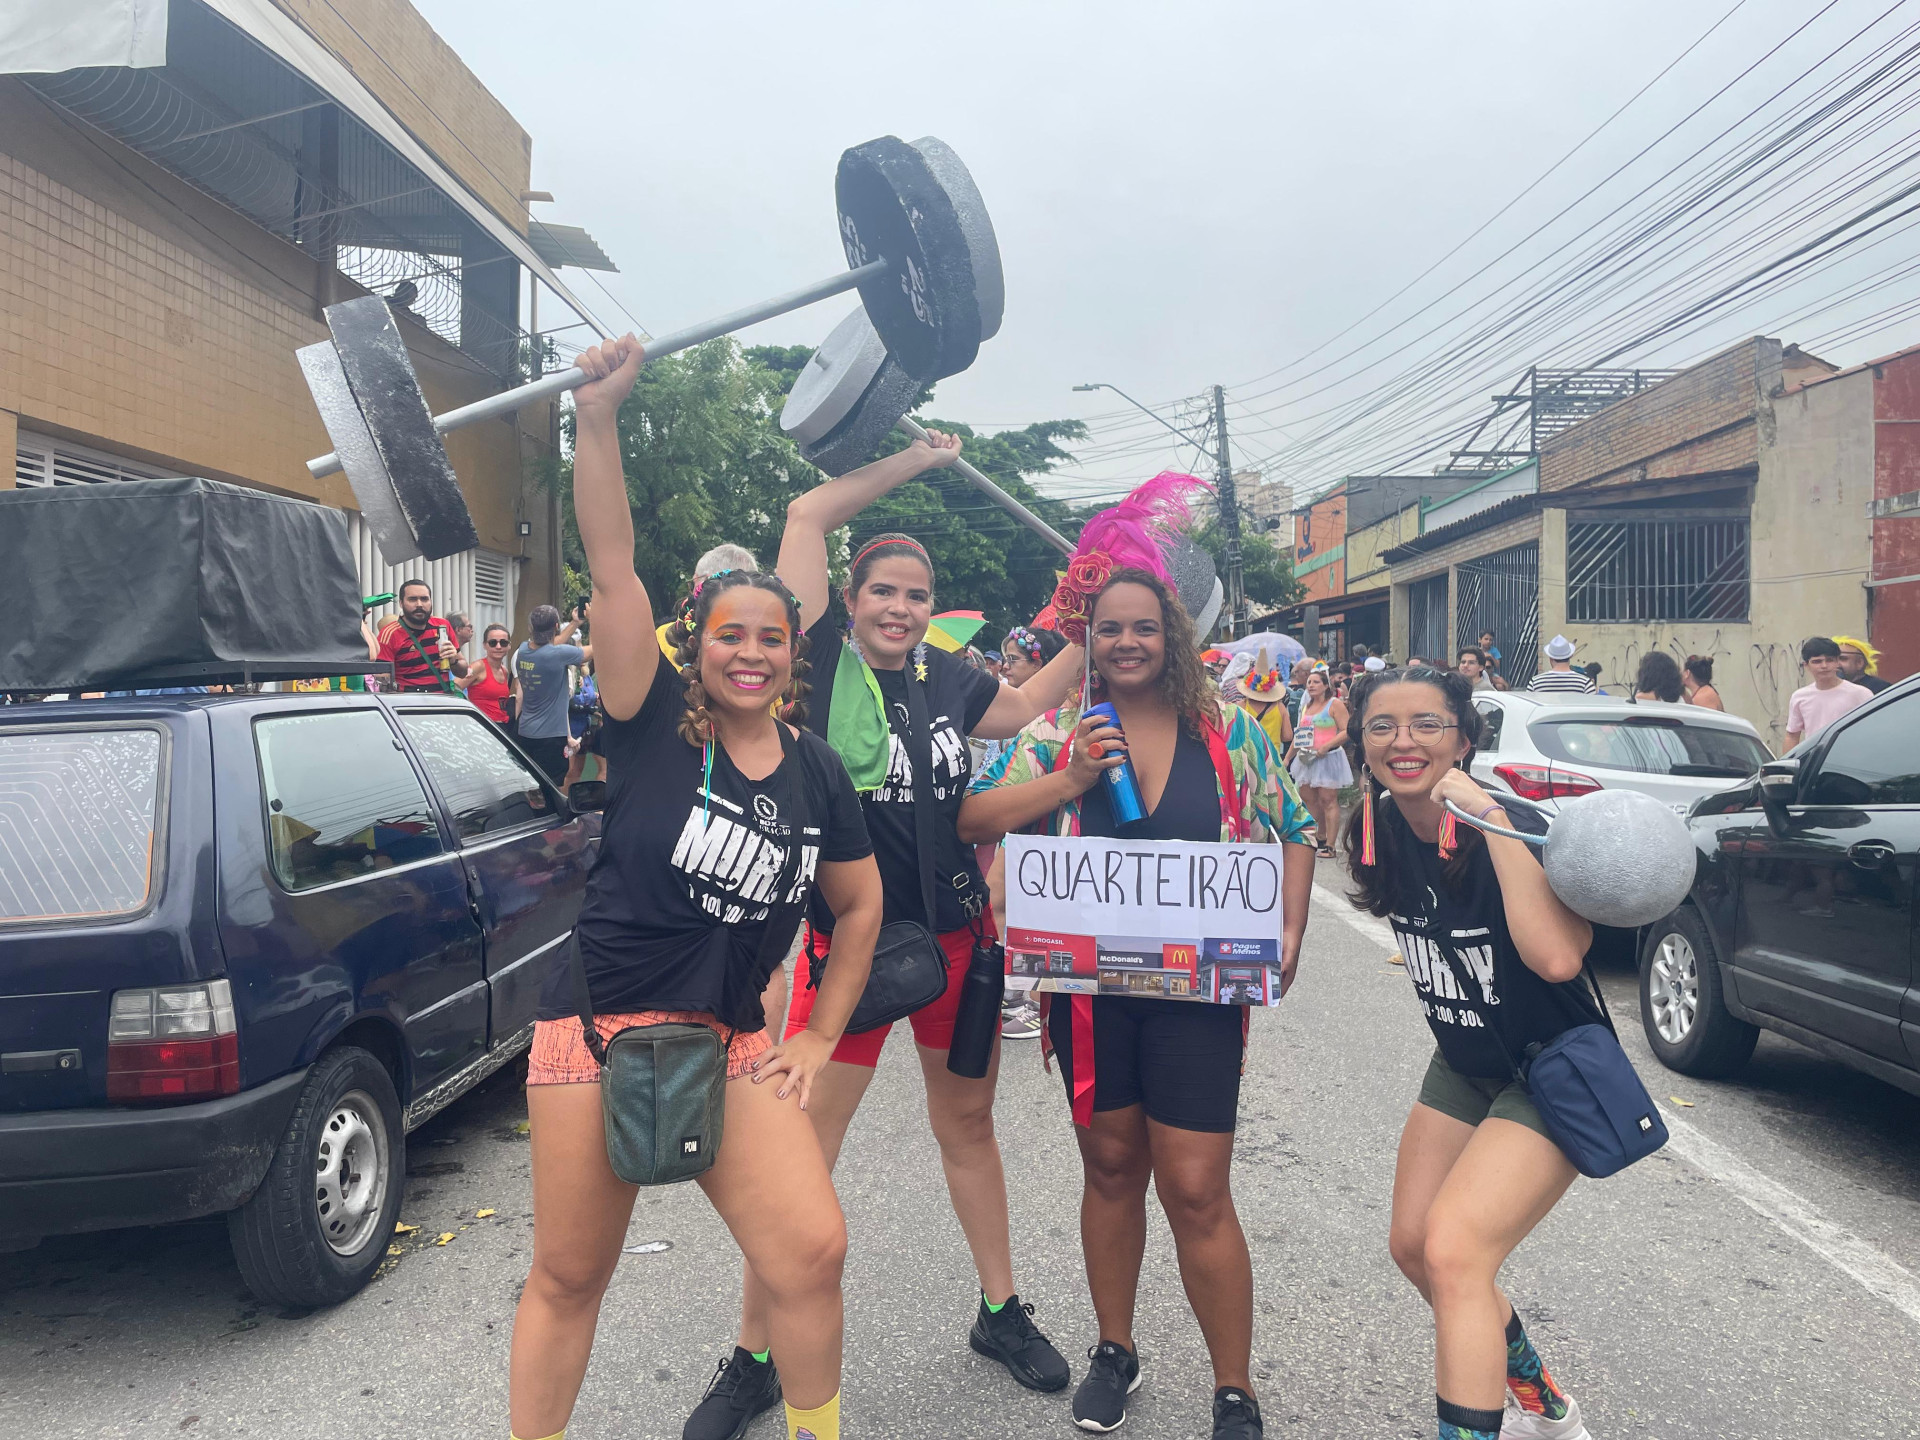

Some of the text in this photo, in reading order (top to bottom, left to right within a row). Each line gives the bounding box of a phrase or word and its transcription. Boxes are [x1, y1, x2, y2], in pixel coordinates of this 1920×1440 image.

[759, 818, 778, 828] BOX
[1018, 849, 1278, 914] QUARTEIRÃO
[1032, 936, 1065, 946] DROGASIL
[1099, 955, 1144, 964] McDonald's
